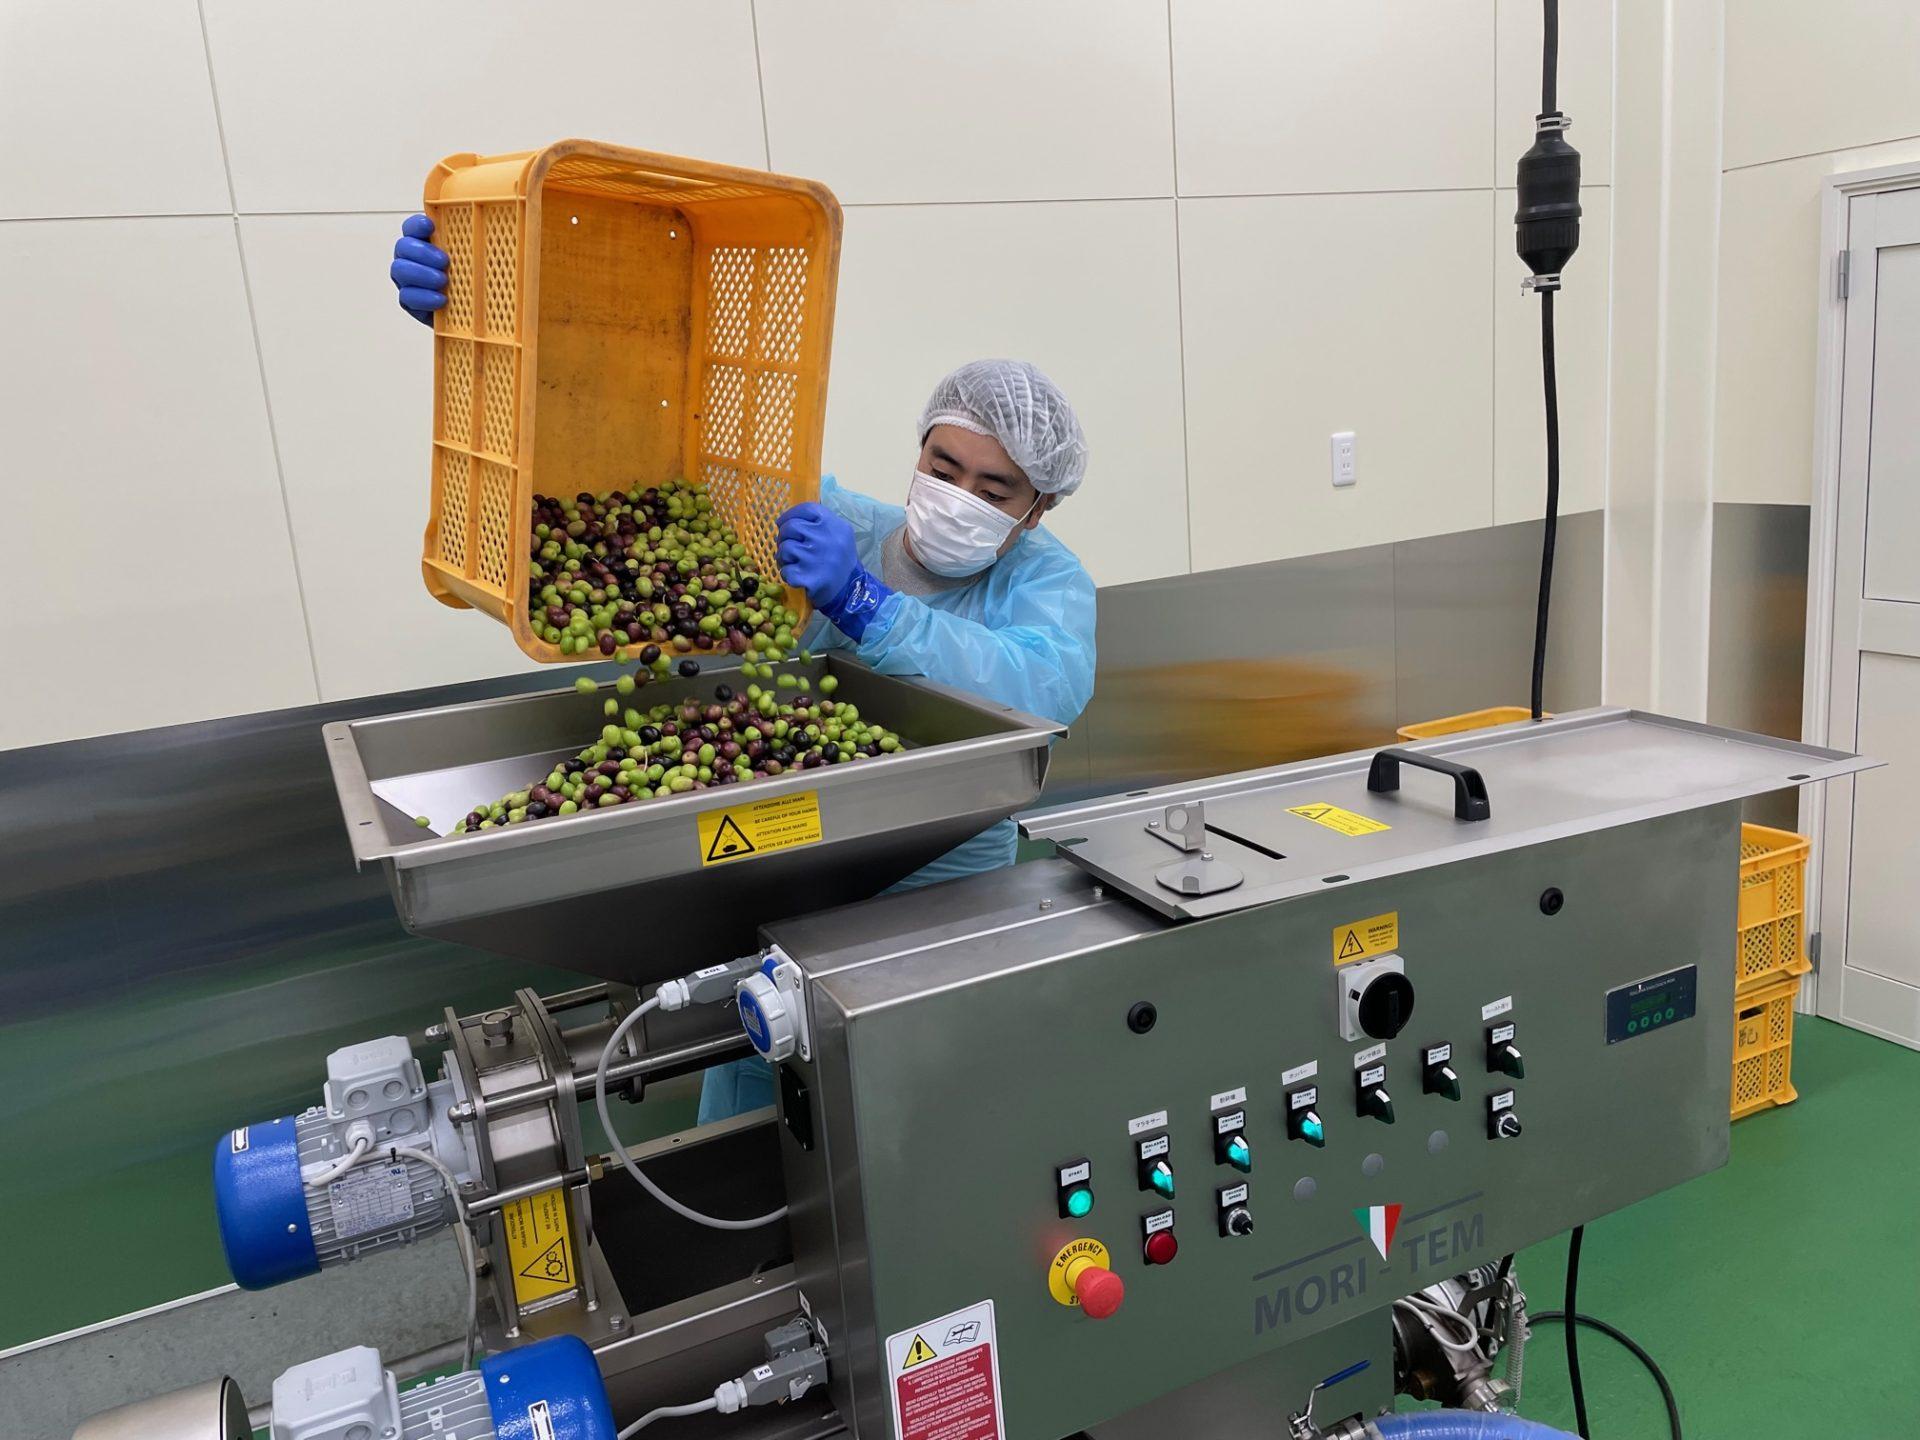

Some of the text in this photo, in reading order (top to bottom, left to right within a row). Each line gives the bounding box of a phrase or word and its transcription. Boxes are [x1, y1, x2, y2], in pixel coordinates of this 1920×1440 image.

[1056, 1241, 1103, 1268] EMERGENCY
[1254, 1256, 1367, 1335] MORI
[1402, 1212, 1484, 1274] TEM
